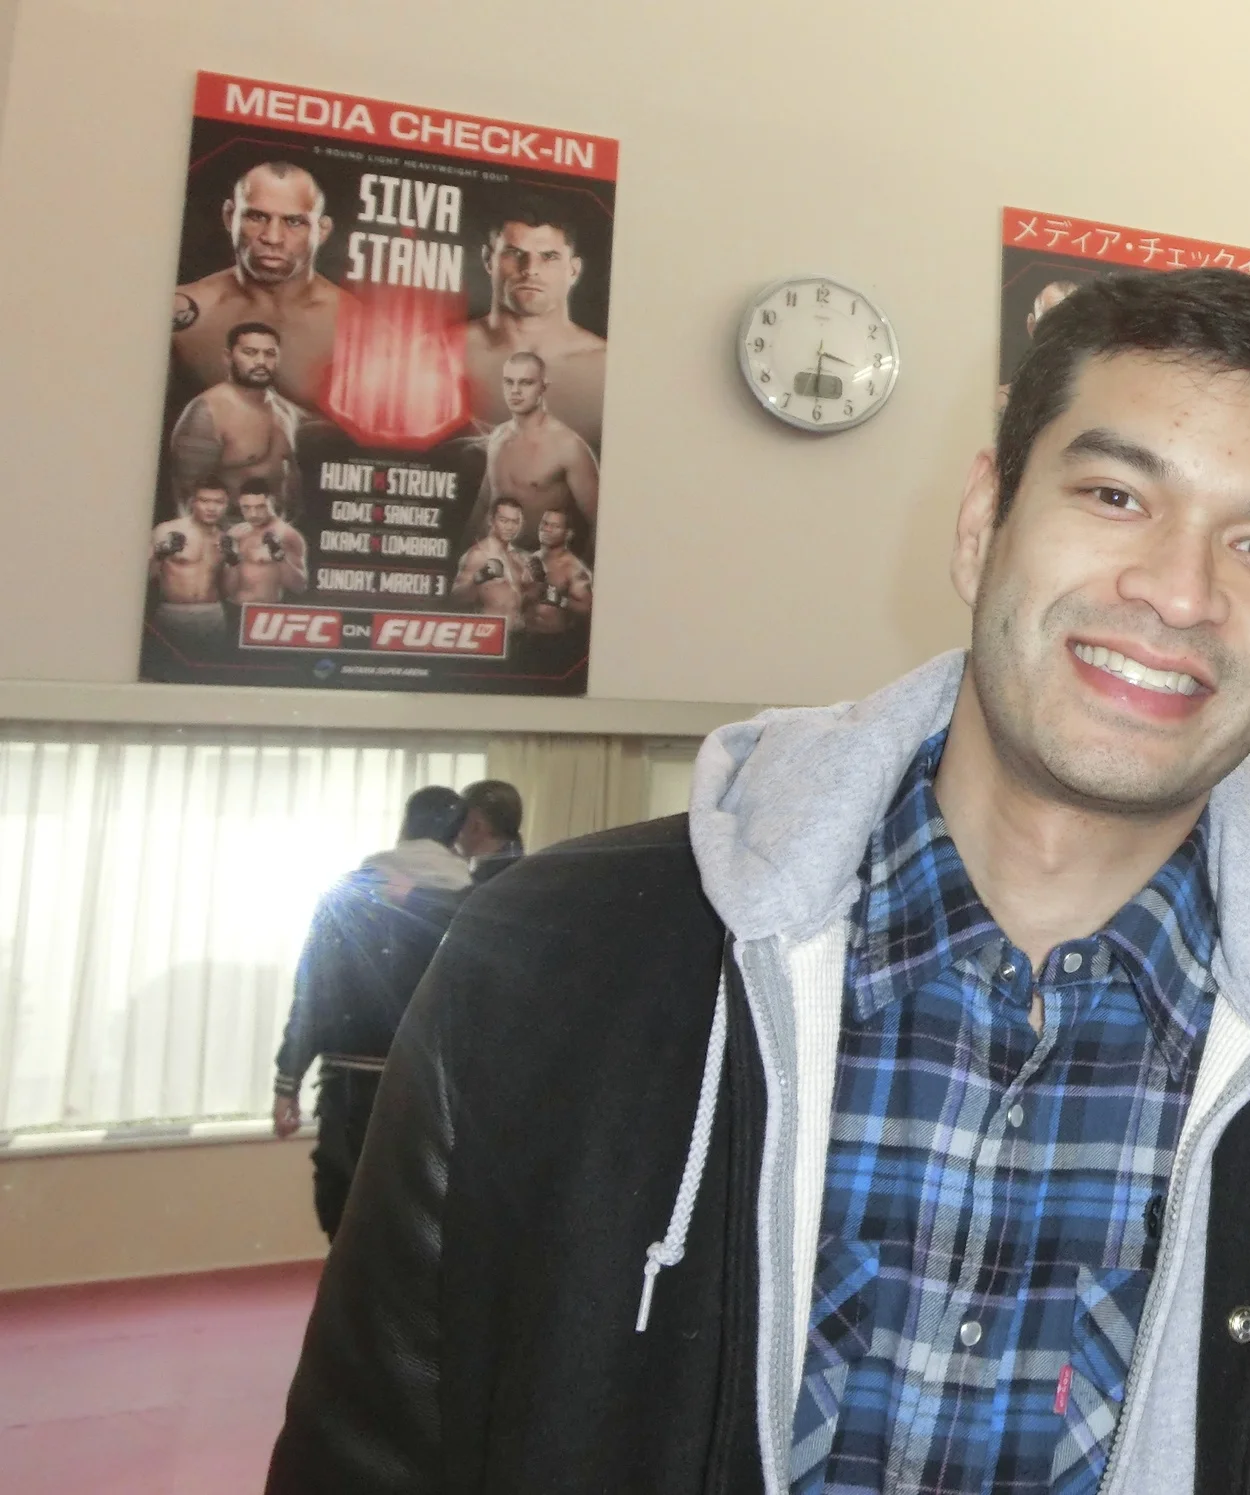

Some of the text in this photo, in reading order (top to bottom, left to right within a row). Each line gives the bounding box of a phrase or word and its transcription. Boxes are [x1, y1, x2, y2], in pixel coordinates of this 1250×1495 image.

[225, 83, 594, 169] MEDIA CHECK-IN
[404, 159, 479, 177] HEAVYWEIGHT
[357, 173, 462, 234] SILVA
[346, 231, 464, 293] STANN
[786, 291, 798, 307] 11
[817, 289, 831, 304] 12
[851, 301, 857, 316] 1
[763, 311, 777, 326] 10
[868, 325, 878, 340] 2
[754, 338, 765, 353] 9
[873, 354, 883, 369] 3
[761, 369, 771, 383] 8
[867, 381, 876, 396] 4
[781, 394, 792, 409] 7
[844, 400, 854, 416] 5
[812, 406, 823, 422] 6
[320, 461, 375, 493] HUNT
[386, 466, 458, 499] STRUVE
[331, 500, 374, 523] GOMI
[383, 504, 440, 528] SANCHEZ
[320, 530, 371, 553] OKAMI
[317, 568, 446, 596] SUNDAY, MARCH 3
[249, 611, 338, 643] UFC
[342, 624, 372, 638] ON
[376, 619, 481, 649] FUEL
